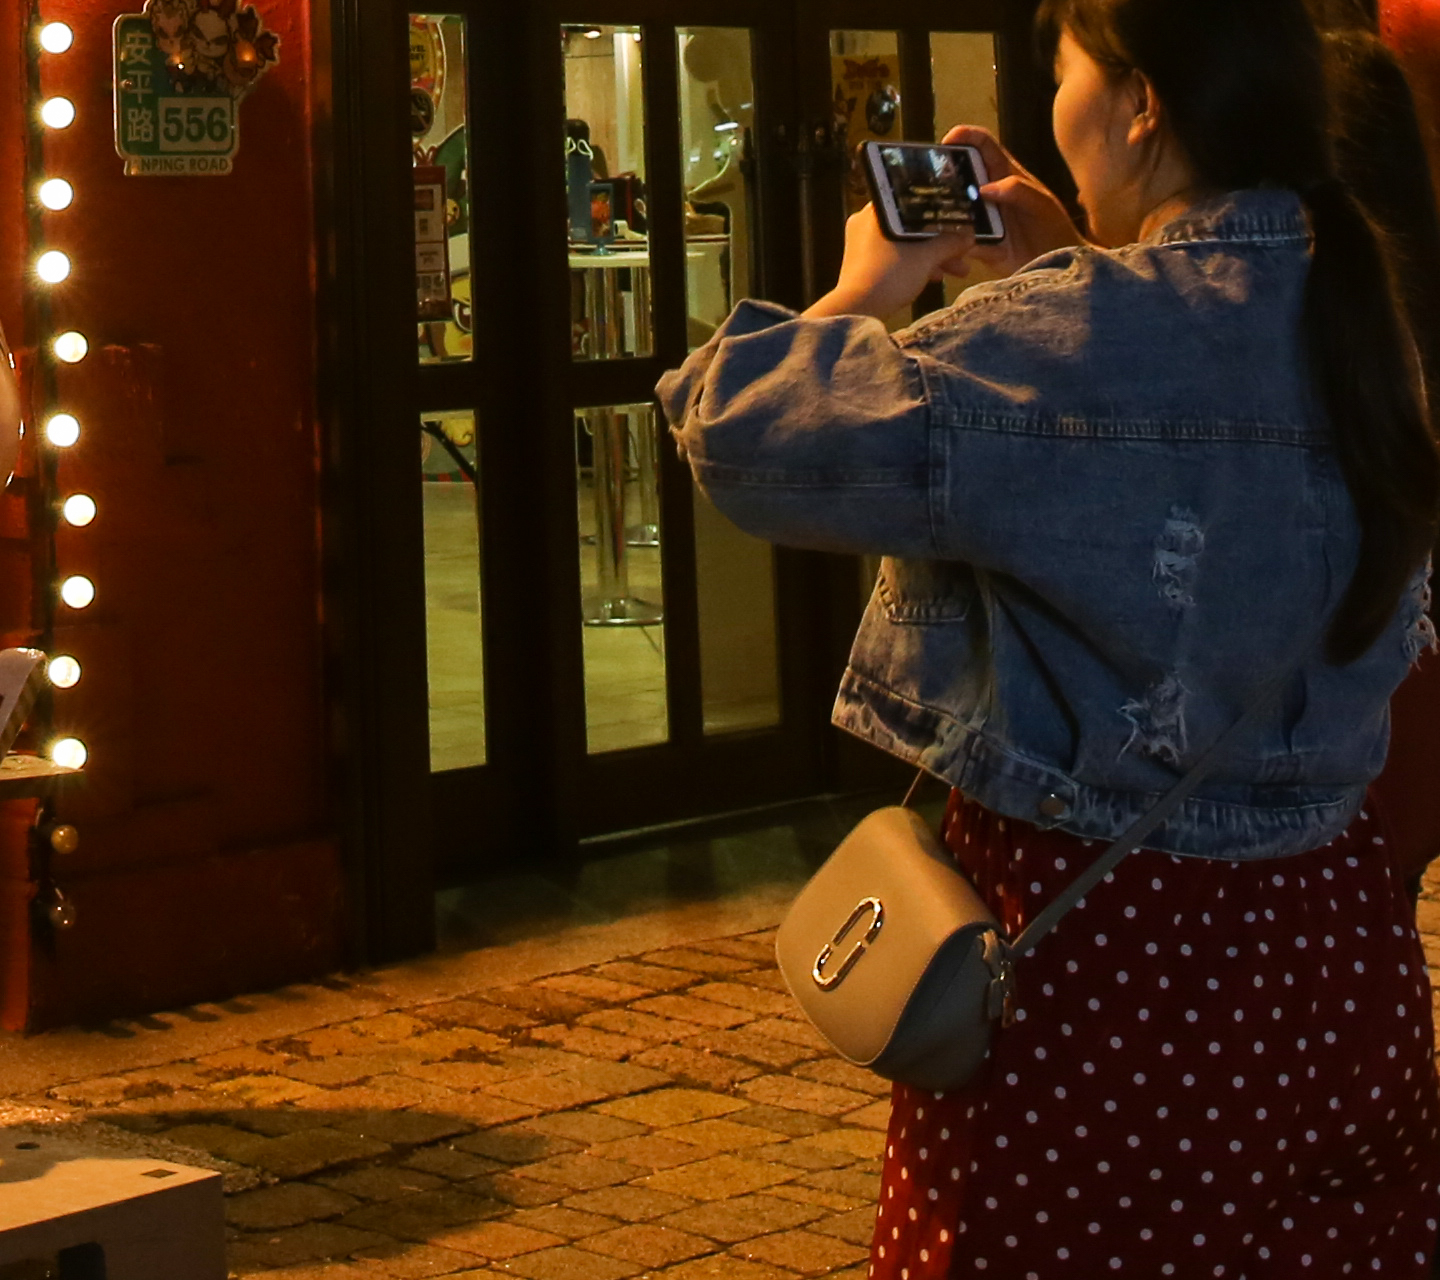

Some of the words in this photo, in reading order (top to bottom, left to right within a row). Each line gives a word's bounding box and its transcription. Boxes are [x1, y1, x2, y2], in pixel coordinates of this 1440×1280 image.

[125, 29, 154, 143] 安平路
[163, 107, 228, 143] 556
[132, 158, 184, 171] NPING
[189, 158, 228, 171] ROAD
